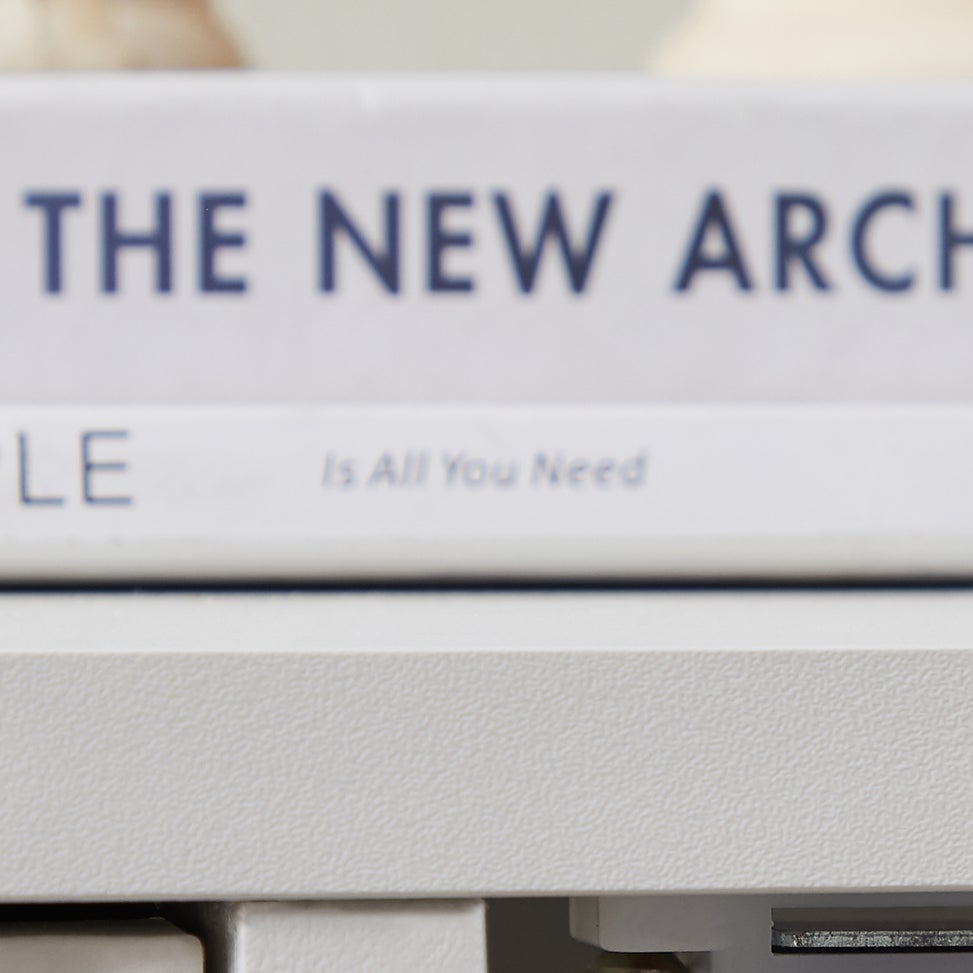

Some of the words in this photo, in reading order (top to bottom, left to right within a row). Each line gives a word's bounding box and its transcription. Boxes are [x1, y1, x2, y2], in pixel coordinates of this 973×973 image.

[23, 190, 250, 296] THE
[316, 189, 615, 297] NEW
[0, 428, 134, 508] LE
[322, 453, 356, 489] Is
[366, 450, 431, 489] All
[442, 451, 519, 489] You
[530, 450, 649, 489] Need
